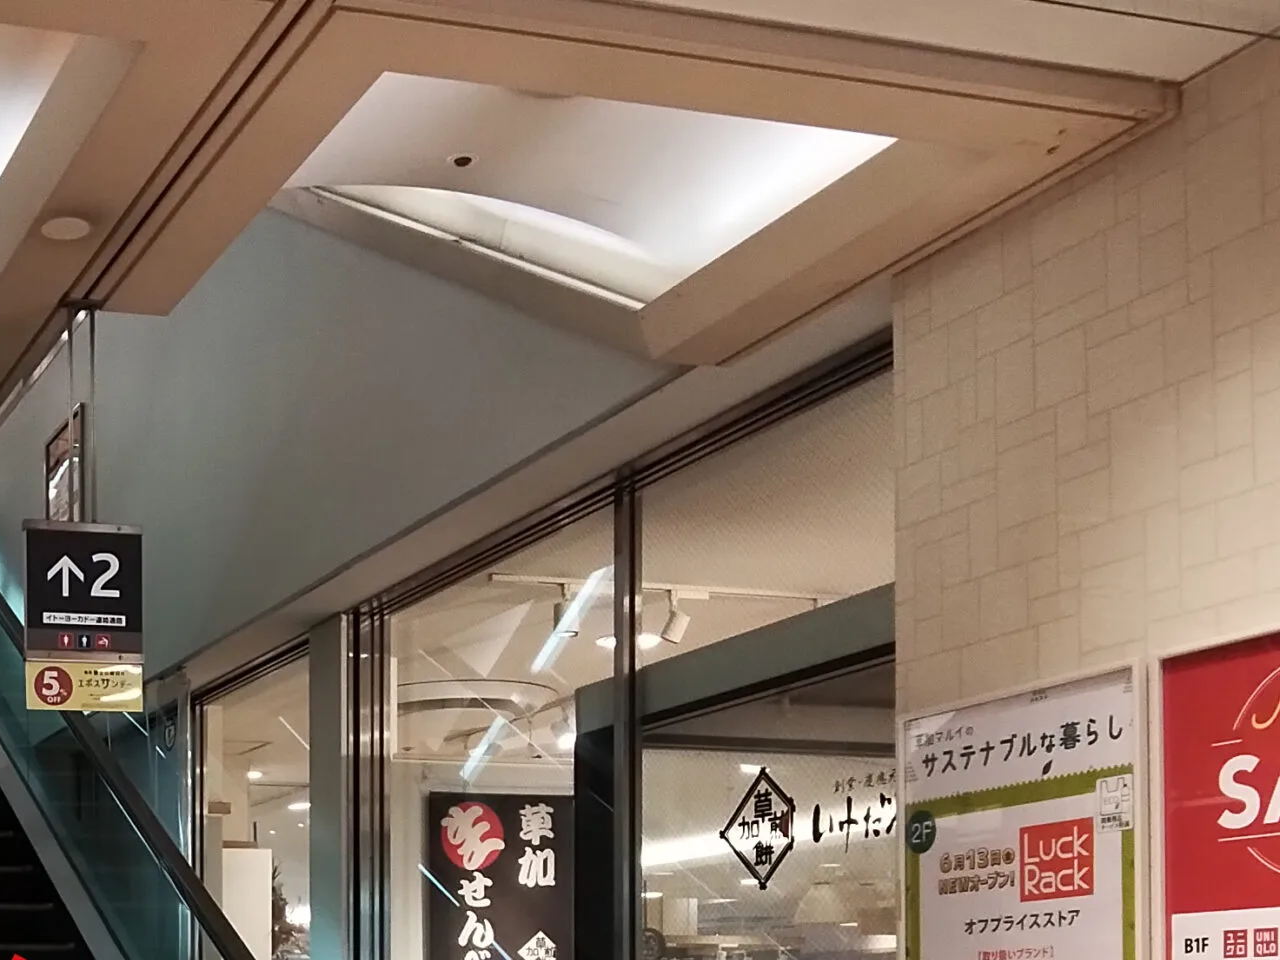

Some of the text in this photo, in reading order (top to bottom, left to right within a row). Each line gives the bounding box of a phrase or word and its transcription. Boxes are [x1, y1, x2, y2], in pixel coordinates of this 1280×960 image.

[90, 552, 120, 598] 2
[922, 715, 1123, 778] サステナブルな暮らし
[812, 792, 897, 854] いけだ
[911, 822, 932, 844] 2F
[518, 803, 556, 888] 草加
[1024, 826, 1090, 863] Luck
[1024, 859, 1090, 895] Rack
[1184, 937, 1209, 954] B1F
